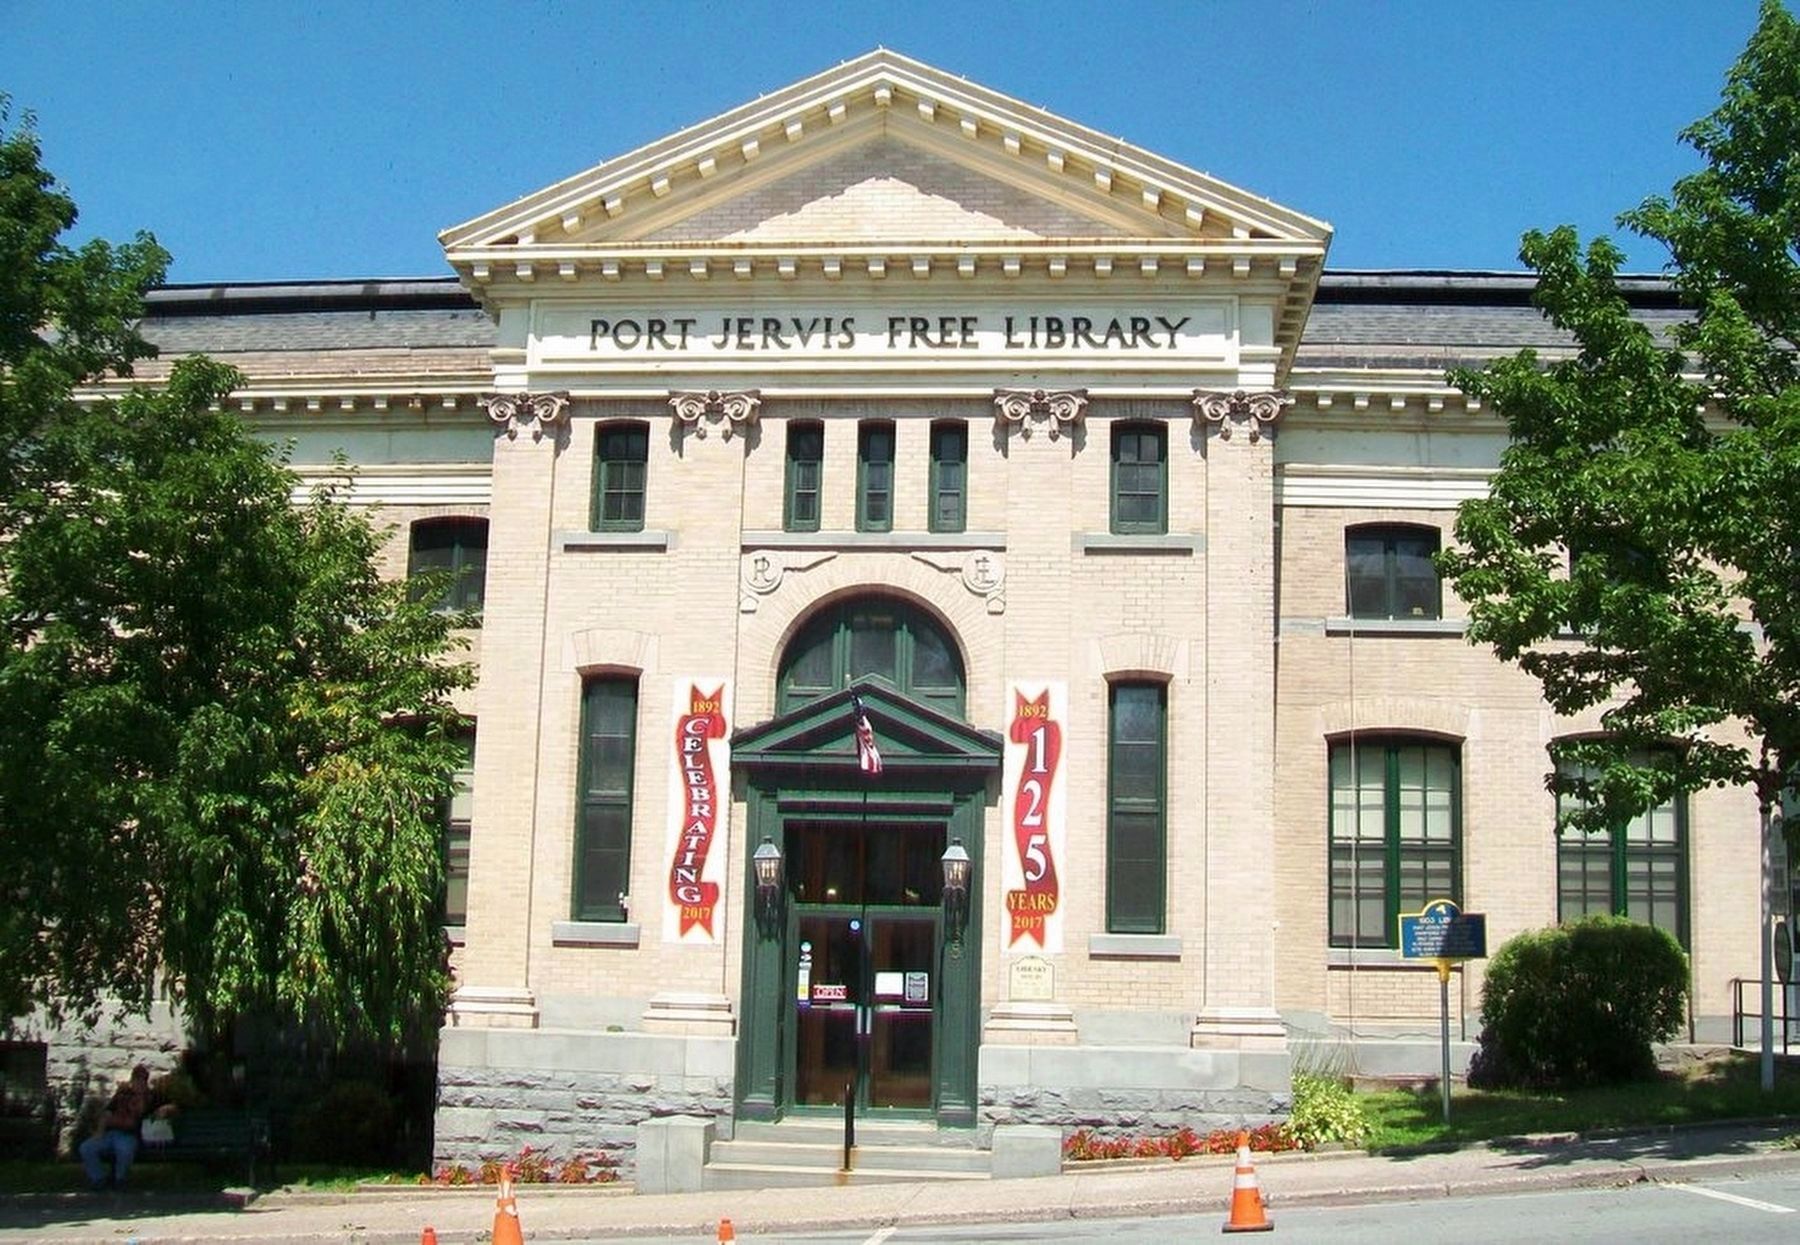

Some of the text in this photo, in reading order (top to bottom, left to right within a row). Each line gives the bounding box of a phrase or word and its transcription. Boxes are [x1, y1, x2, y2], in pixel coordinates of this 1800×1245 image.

[590, 316, 1191, 350] PORT JERVIS FREE LIBRARY
[693, 700, 720, 713] 1892
[1018, 704, 1047, 718] 1892
[675, 718, 711, 903] CELEBRATING
[1021, 726, 1048, 882] 125
[1009, 892, 1056, 910] YEARS
[682, 906, 711, 919] 2017
[1014, 915, 1042, 929] 2017
[815, 987, 845, 997] OPEN
